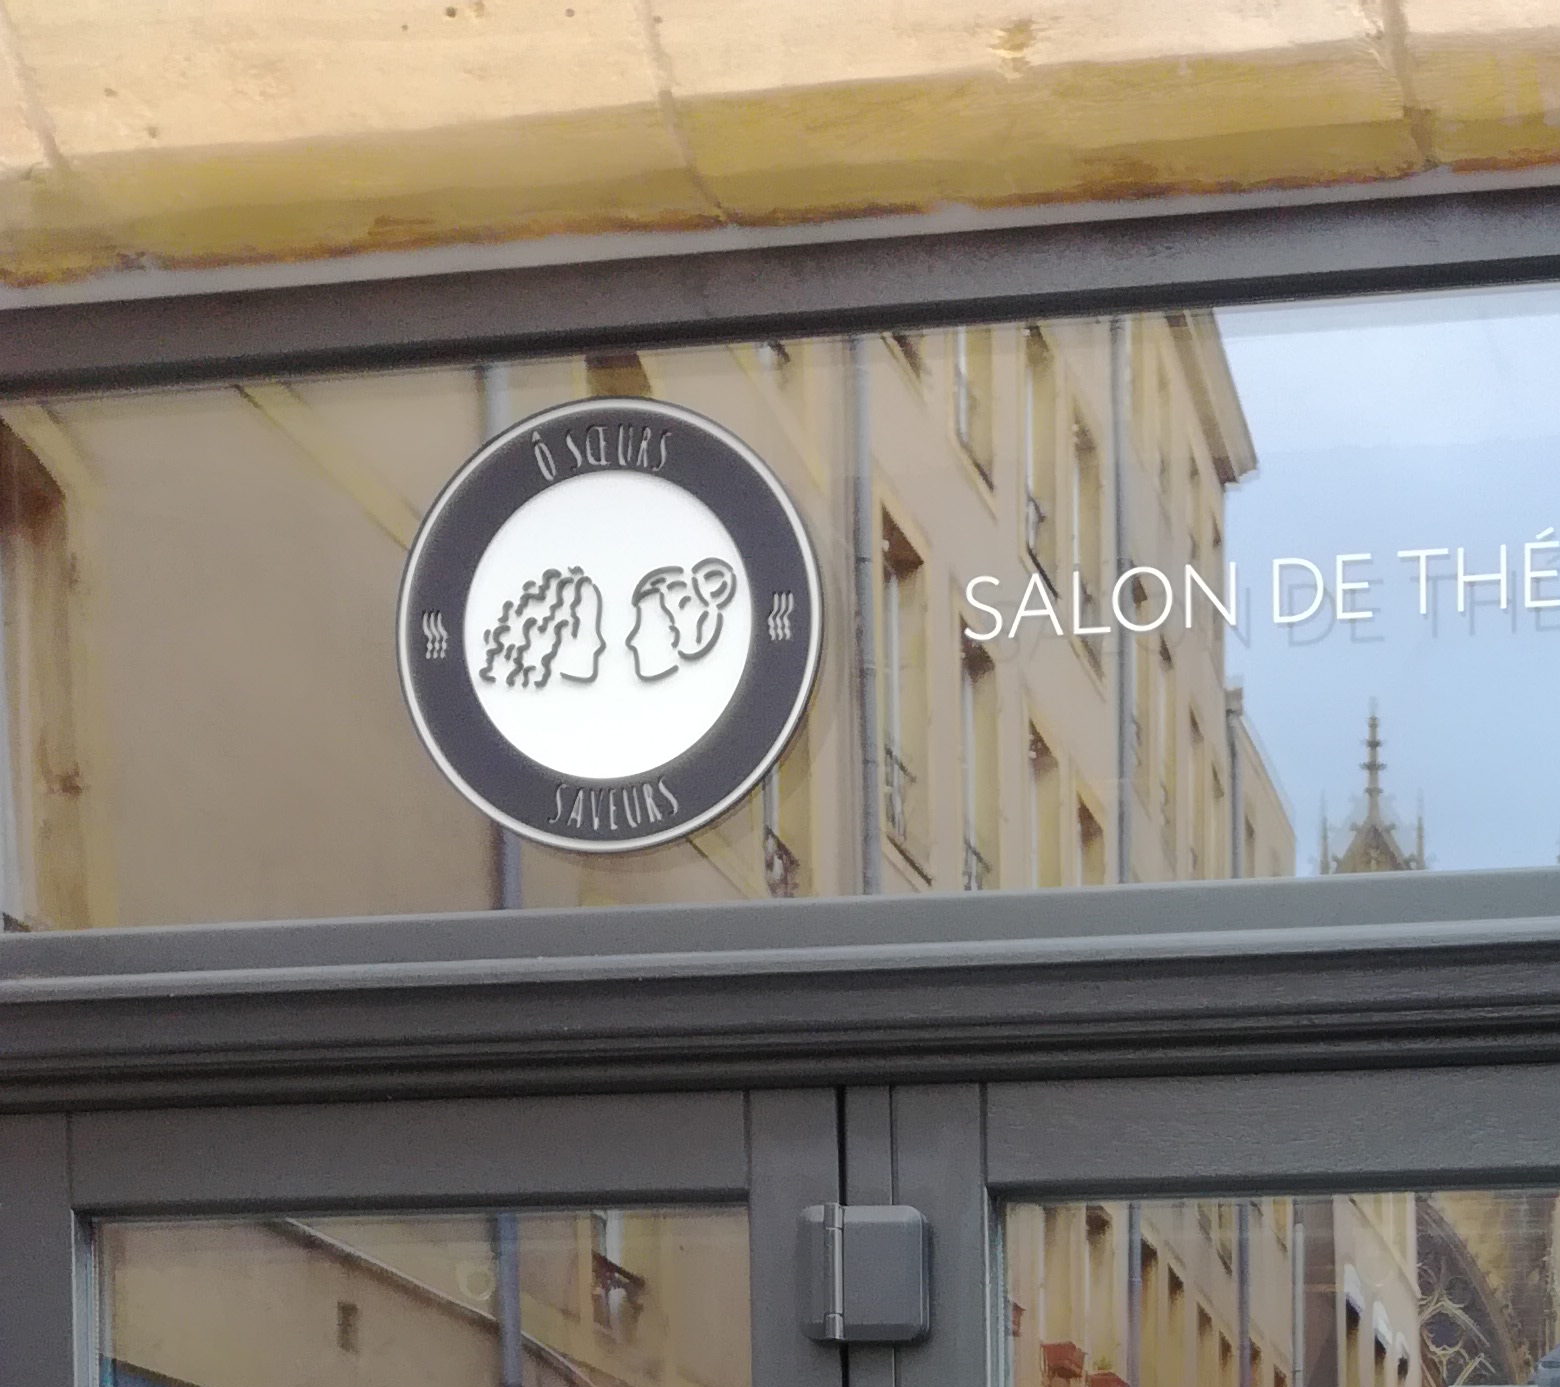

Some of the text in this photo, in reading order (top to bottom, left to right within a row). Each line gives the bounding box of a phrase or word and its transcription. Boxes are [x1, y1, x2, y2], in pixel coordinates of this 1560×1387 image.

[963, 561, 1239, 641] SALON
[1272, 552, 1374, 624] DE
[548, 774, 679, 831] SAVEURS
